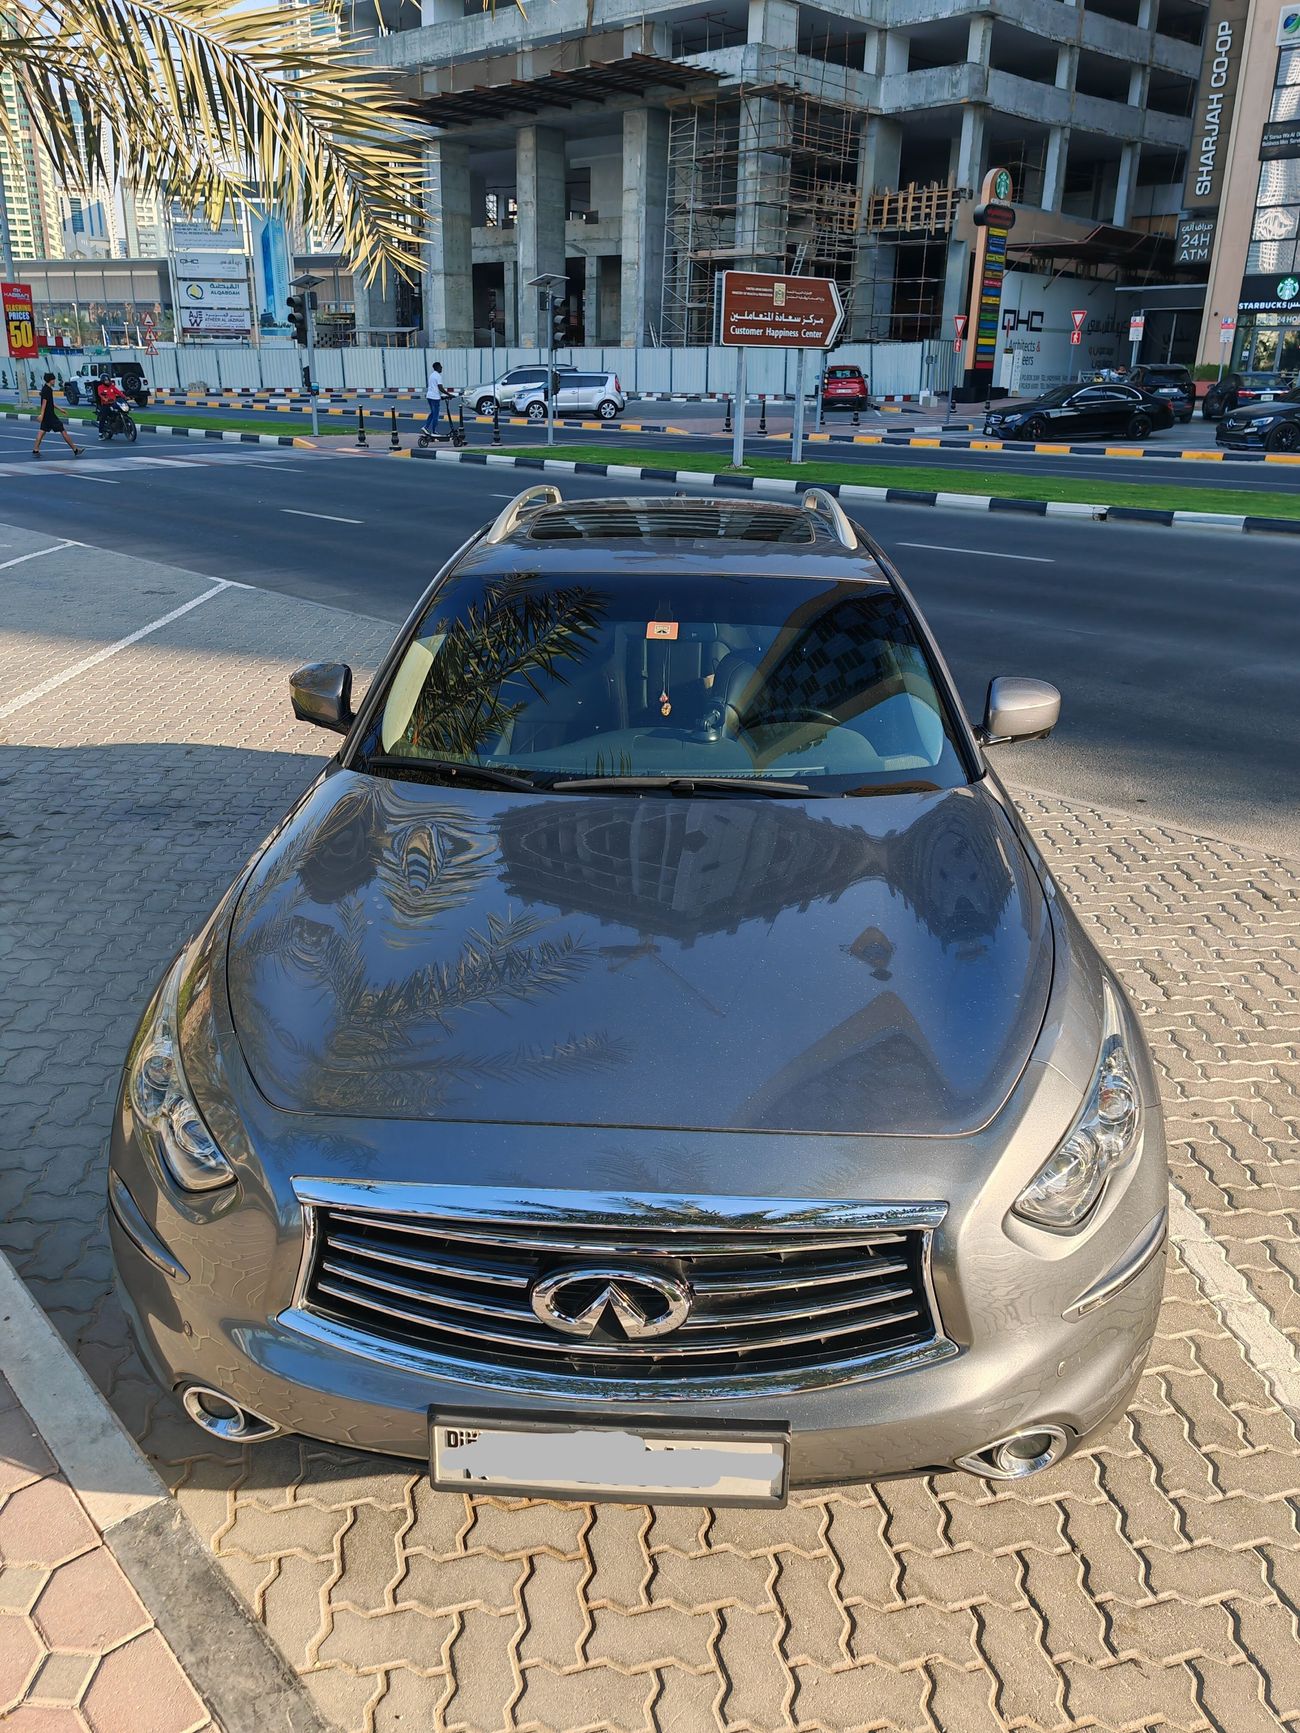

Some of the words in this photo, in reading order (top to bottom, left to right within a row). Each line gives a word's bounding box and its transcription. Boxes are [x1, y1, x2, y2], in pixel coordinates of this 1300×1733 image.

[1195, 93, 1224, 196] SHARJAH
[1210, 21, 1233, 88] CO-OP
[1181, 233, 1210, 248] 24H
[1179, 248, 1208, 261] ATM
[1238, 302, 1287, 310] STARBUCKS
[8, 312, 30, 321] PRICES
[730, 310, 774, 322] المتعاملين
[775, 311, 802, 323] سعادة
[801, 314, 824, 326] مركز
[9, 321, 34, 348] 50
[730, 325, 763, 336] Customer
[765, 327, 799, 339] Happiness
[801, 329, 823, 339] Center
